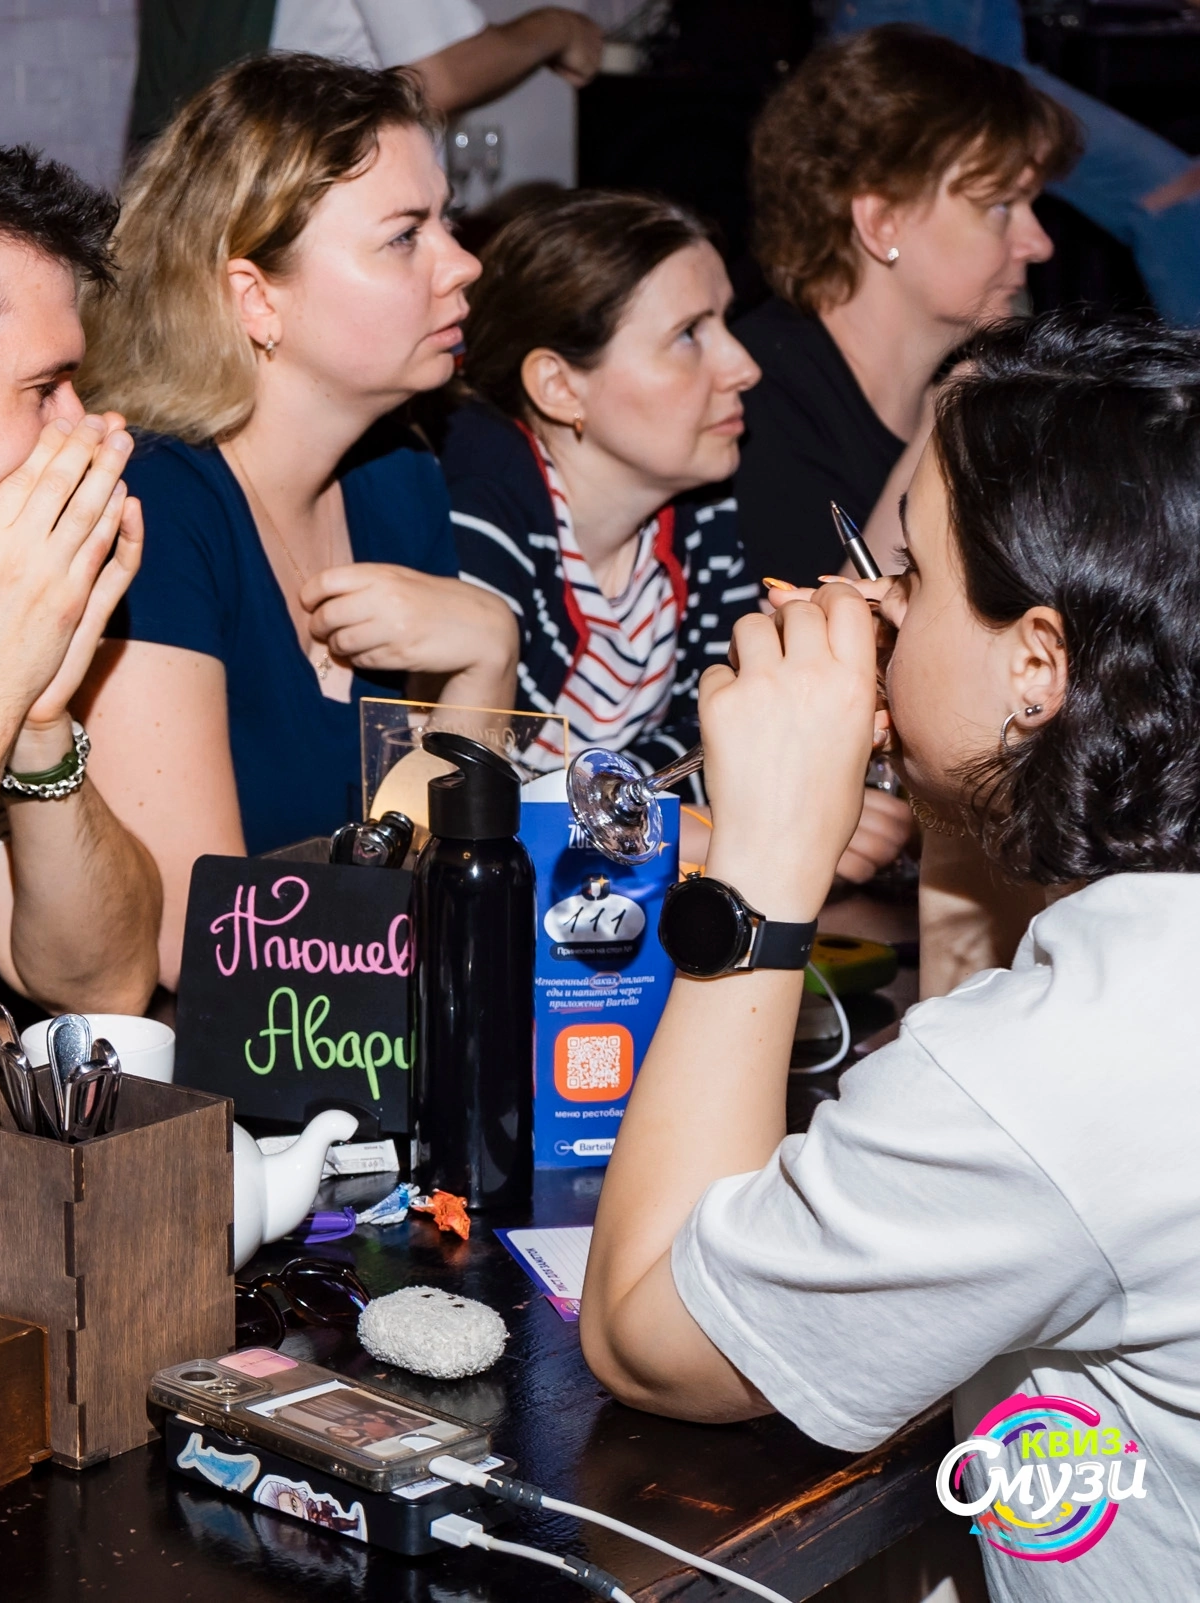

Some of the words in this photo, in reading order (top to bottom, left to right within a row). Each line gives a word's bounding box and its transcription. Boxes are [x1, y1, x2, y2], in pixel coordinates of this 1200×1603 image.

[563, 906, 626, 934] 111
[546, 989, 563, 997] еды
[572, 989, 617, 997] напитков
[619, 987, 642, 997] через
[549, 999, 603, 1009] приложение
[606, 997, 639, 1007] Bartello
[555, 1110, 580, 1118] меню
